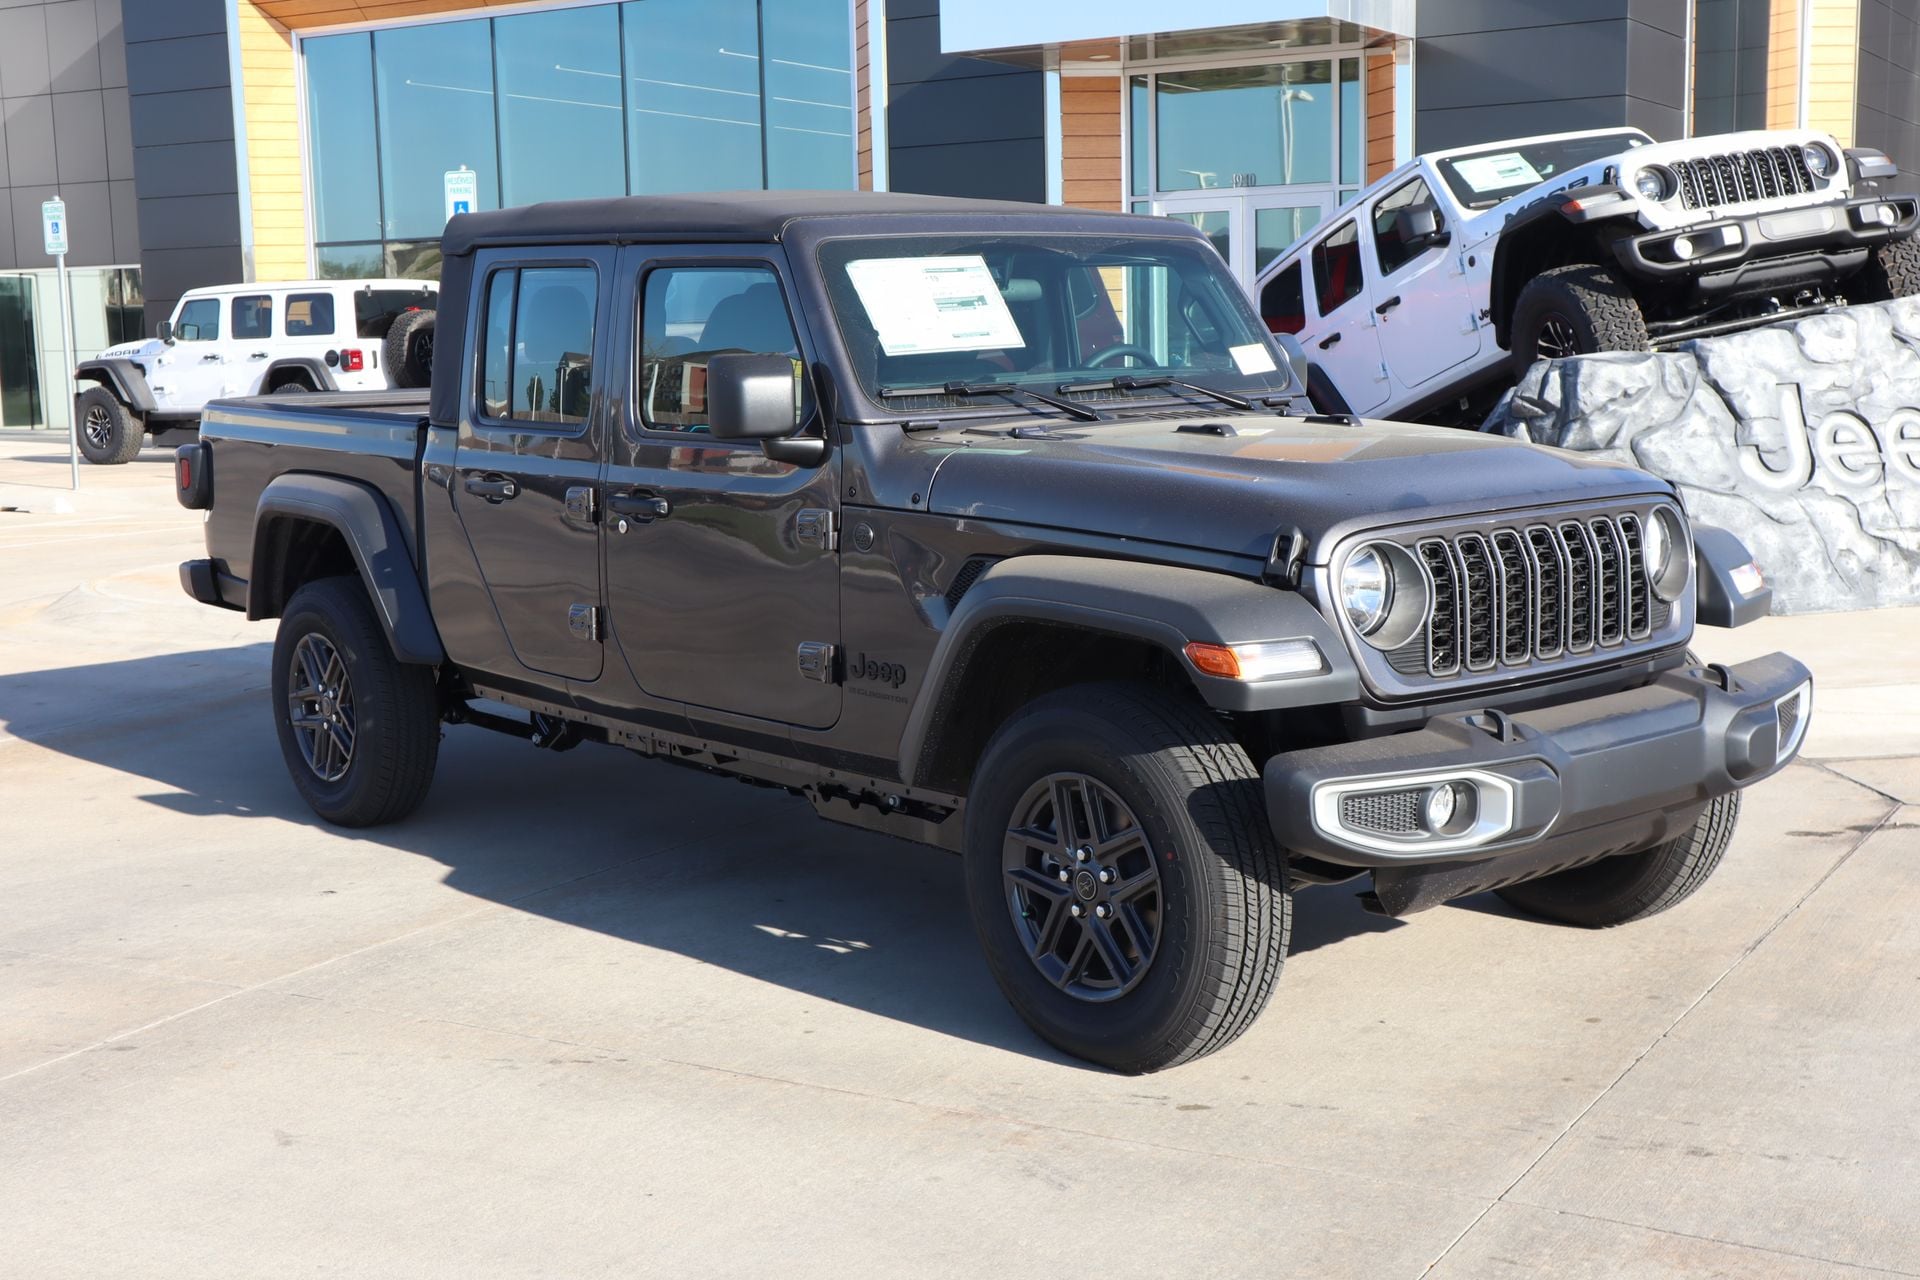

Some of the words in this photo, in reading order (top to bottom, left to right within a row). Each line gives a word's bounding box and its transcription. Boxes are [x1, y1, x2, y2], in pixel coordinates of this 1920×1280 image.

[1478, 308, 1491, 321] Je
[105, 349, 140, 358] MOAB
[850, 652, 906, 689] Jeep
